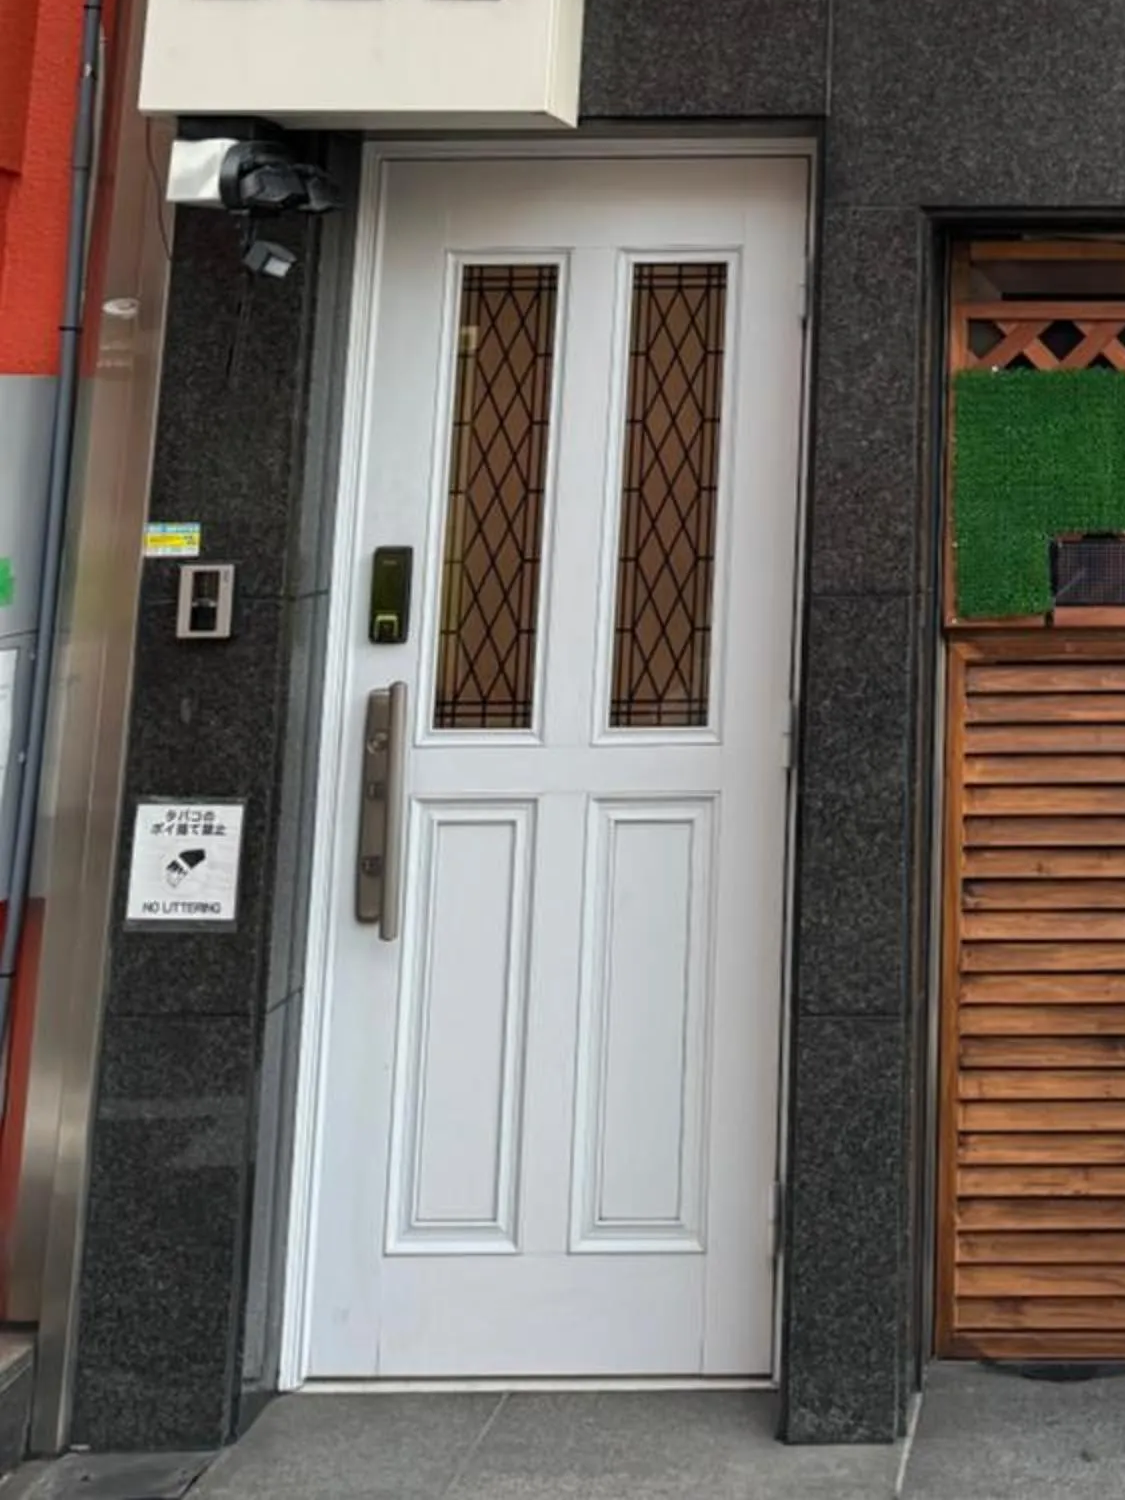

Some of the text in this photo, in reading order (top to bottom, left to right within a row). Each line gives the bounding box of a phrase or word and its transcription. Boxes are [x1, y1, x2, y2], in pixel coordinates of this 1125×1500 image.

[166, 809, 215, 822] タバコの
[150, 822, 226, 835] ポイ捨て禁止
[142, 900, 222, 914] NO LITTERING
